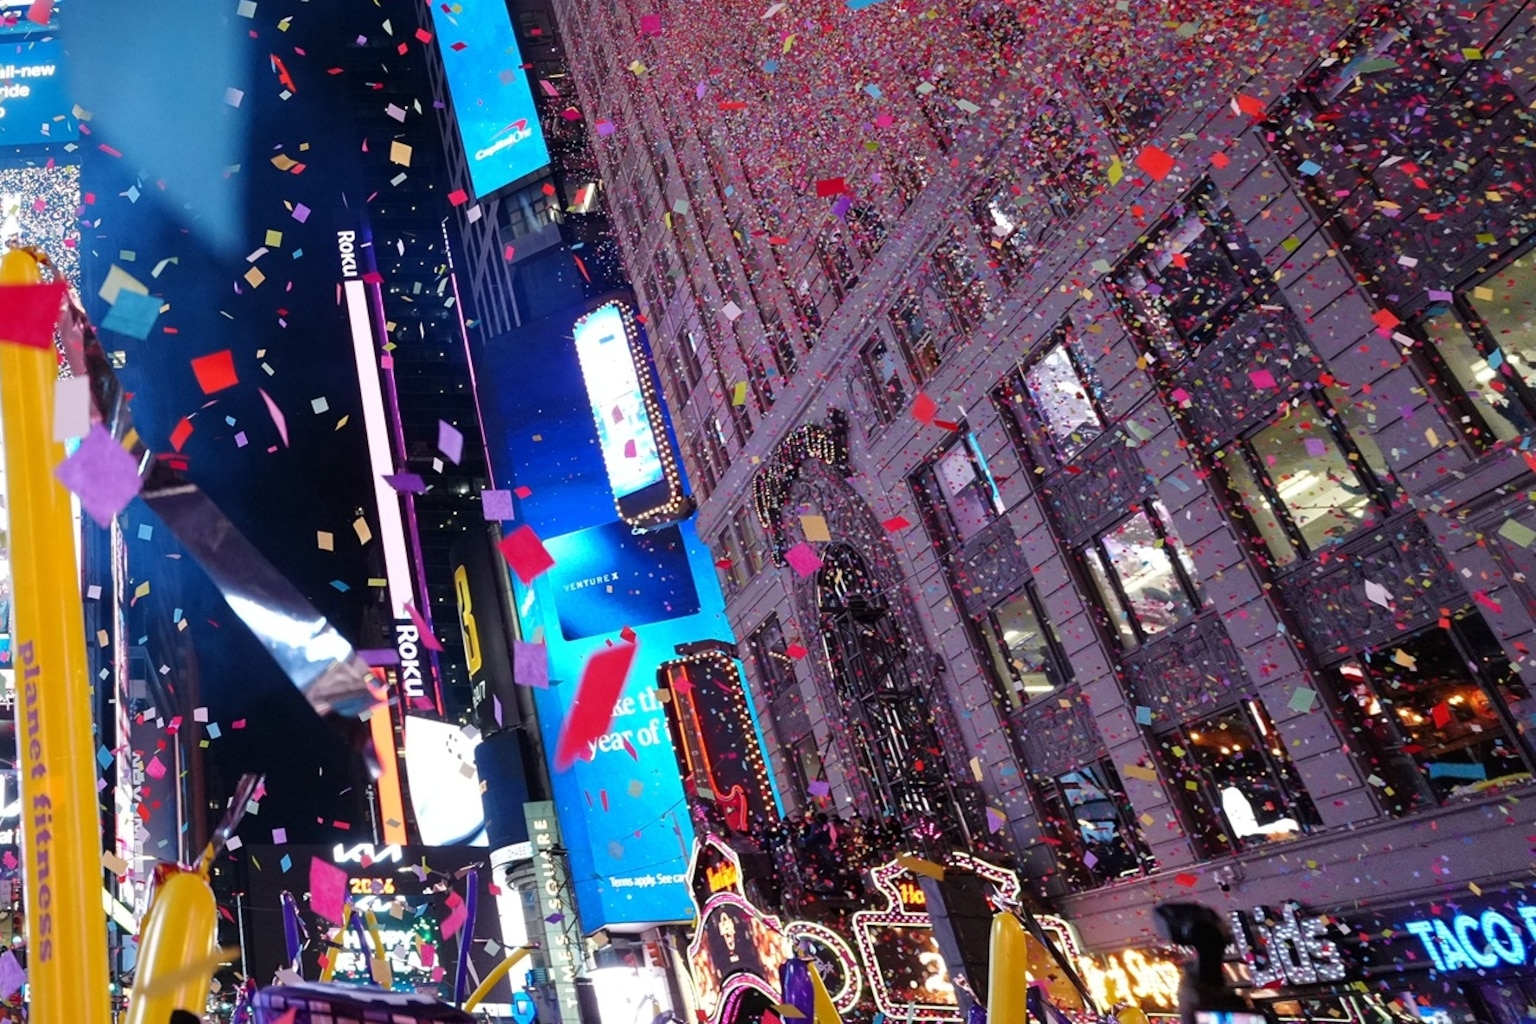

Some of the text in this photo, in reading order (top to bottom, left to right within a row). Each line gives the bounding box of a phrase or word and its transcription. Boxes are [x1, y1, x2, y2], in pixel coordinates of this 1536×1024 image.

[563, 574, 611, 592] VENTURE
[587, 729, 635, 762] year
[637, 718, 660, 746] of
[17, 639, 57, 964] planet fitness
[609, 875, 634, 888] Terms
[634, 874, 657, 889] apply.
[657, 872, 672, 885] See
[533, 818, 579, 1009] TIMES SQUARE
[1405, 910, 1527, 973] TACO
